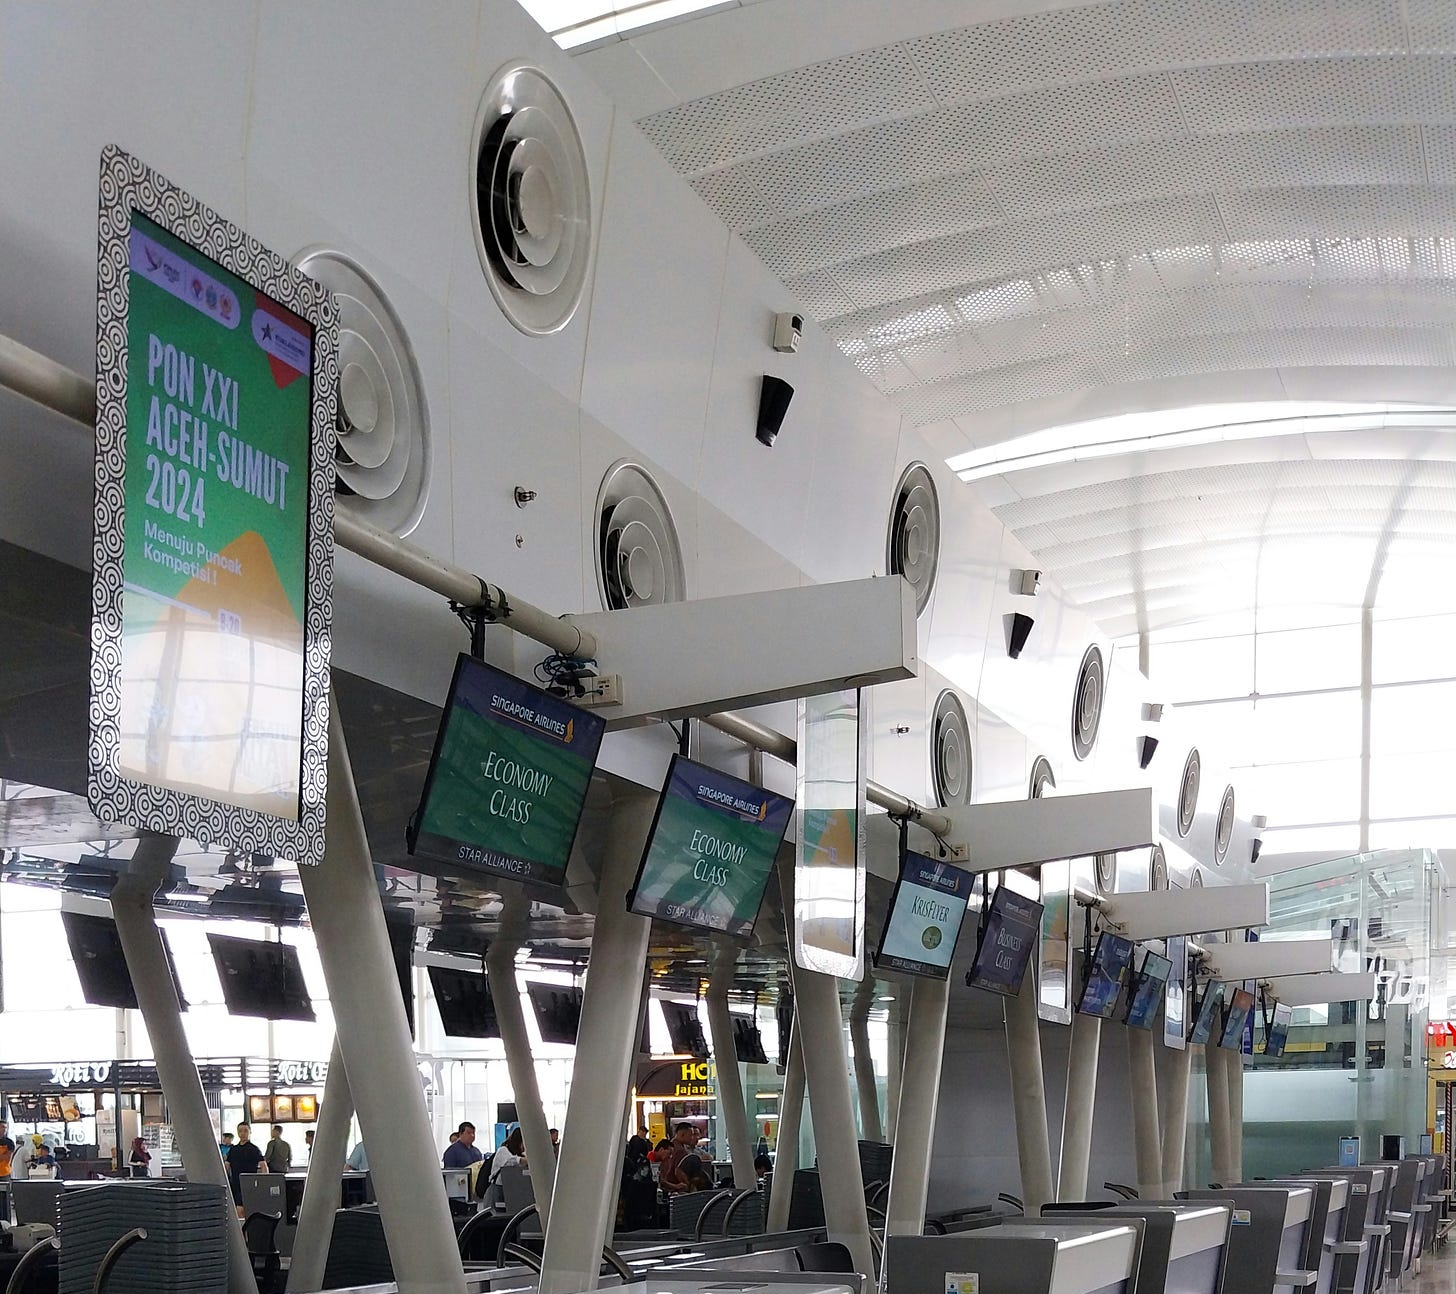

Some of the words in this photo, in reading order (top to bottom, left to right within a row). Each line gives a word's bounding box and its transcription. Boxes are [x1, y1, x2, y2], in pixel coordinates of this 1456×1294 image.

[148, 333, 195, 407] PON
[202, 362, 239, 431] XXI
[146, 395, 290, 510] ACEH-SUMUT
[145, 454, 206, 528] 2024
[144, 519, 194, 556] Menuju
[196, 542, 243, 576] Puncak
[144, 542, 211, 584] Kompetisi
[490, 694, 535, 722] SINGAPORE
[534, 713, 566, 736] AIRLINES
[483, 751, 554, 797] ECONOMY
[489, 789, 532, 824] CLASS
[697, 785, 734, 806] SINGAPORE
[732, 797, 760, 815] AIRLINES
[458, 846, 481, 863] STAR
[481, 852, 524, 874] ALLIANCE
[689, 829, 748, 865] ECONOMY
[693, 859, 729, 887] CLASS
[667, 904, 686, 917] STAR
[686, 909, 721, 924] ALLIANCE
